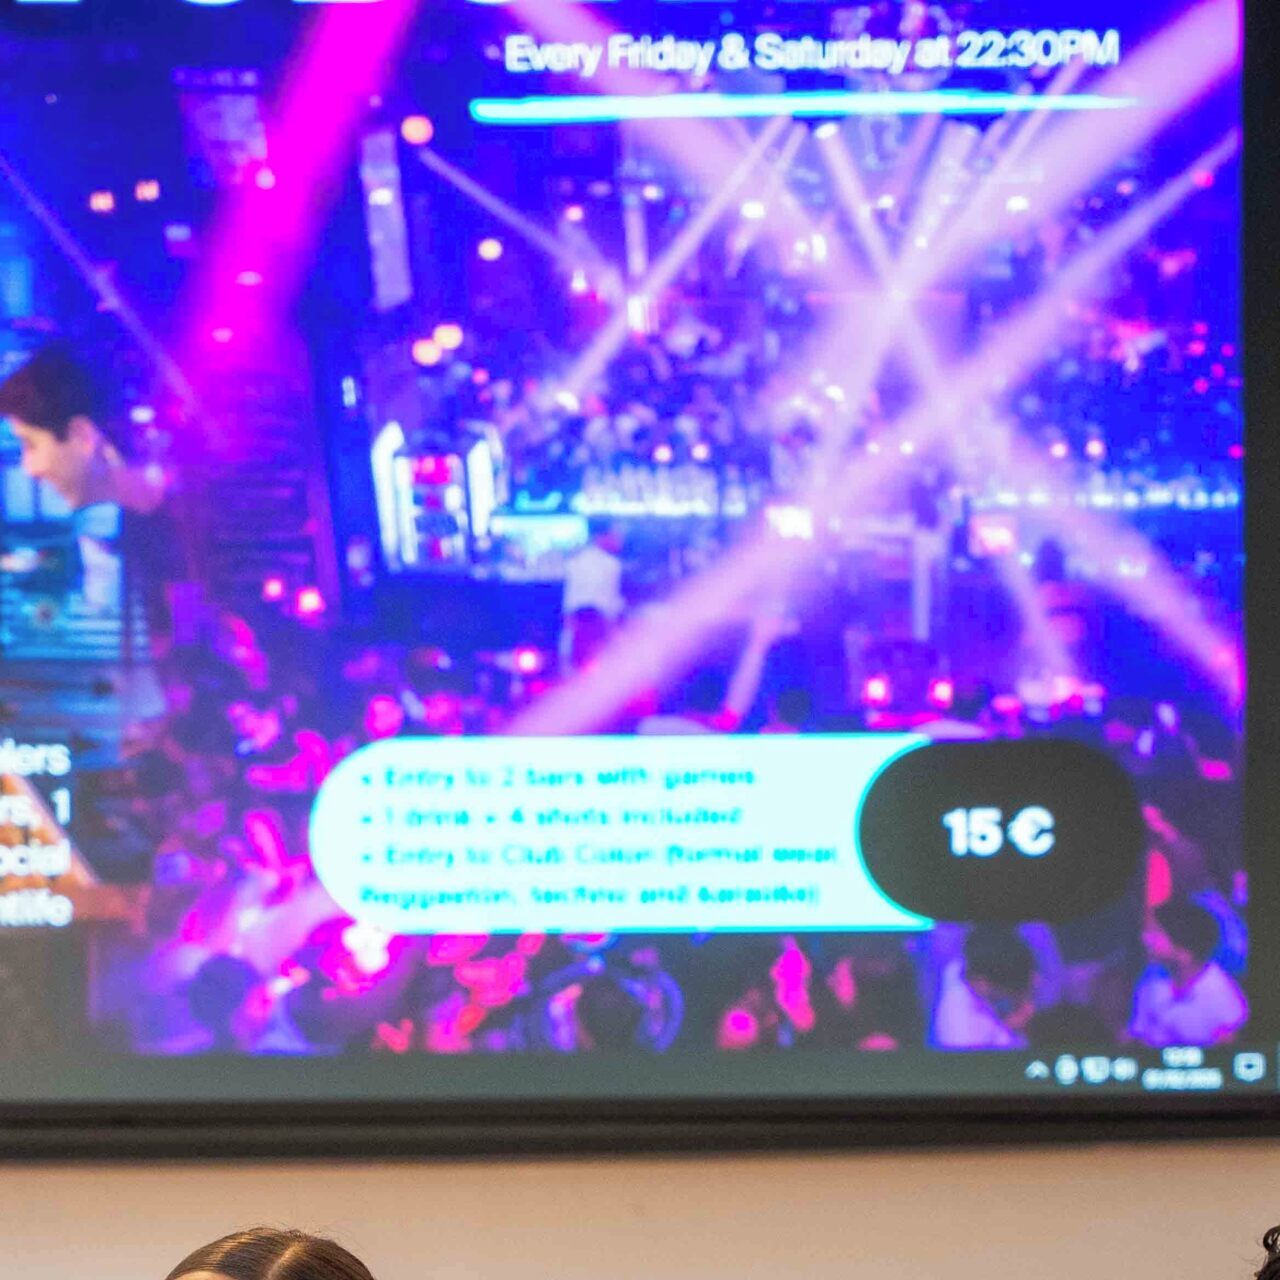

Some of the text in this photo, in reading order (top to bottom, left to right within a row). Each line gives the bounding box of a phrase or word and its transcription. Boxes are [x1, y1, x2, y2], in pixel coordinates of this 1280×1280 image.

[505, 34, 603, 77] Every
[608, 34, 715, 78] Friday
[718, 32, 750, 71] &
[754, 32, 912, 75] Saturday
[914, 34, 953, 69] at
[51, 787, 72, 826] 1
